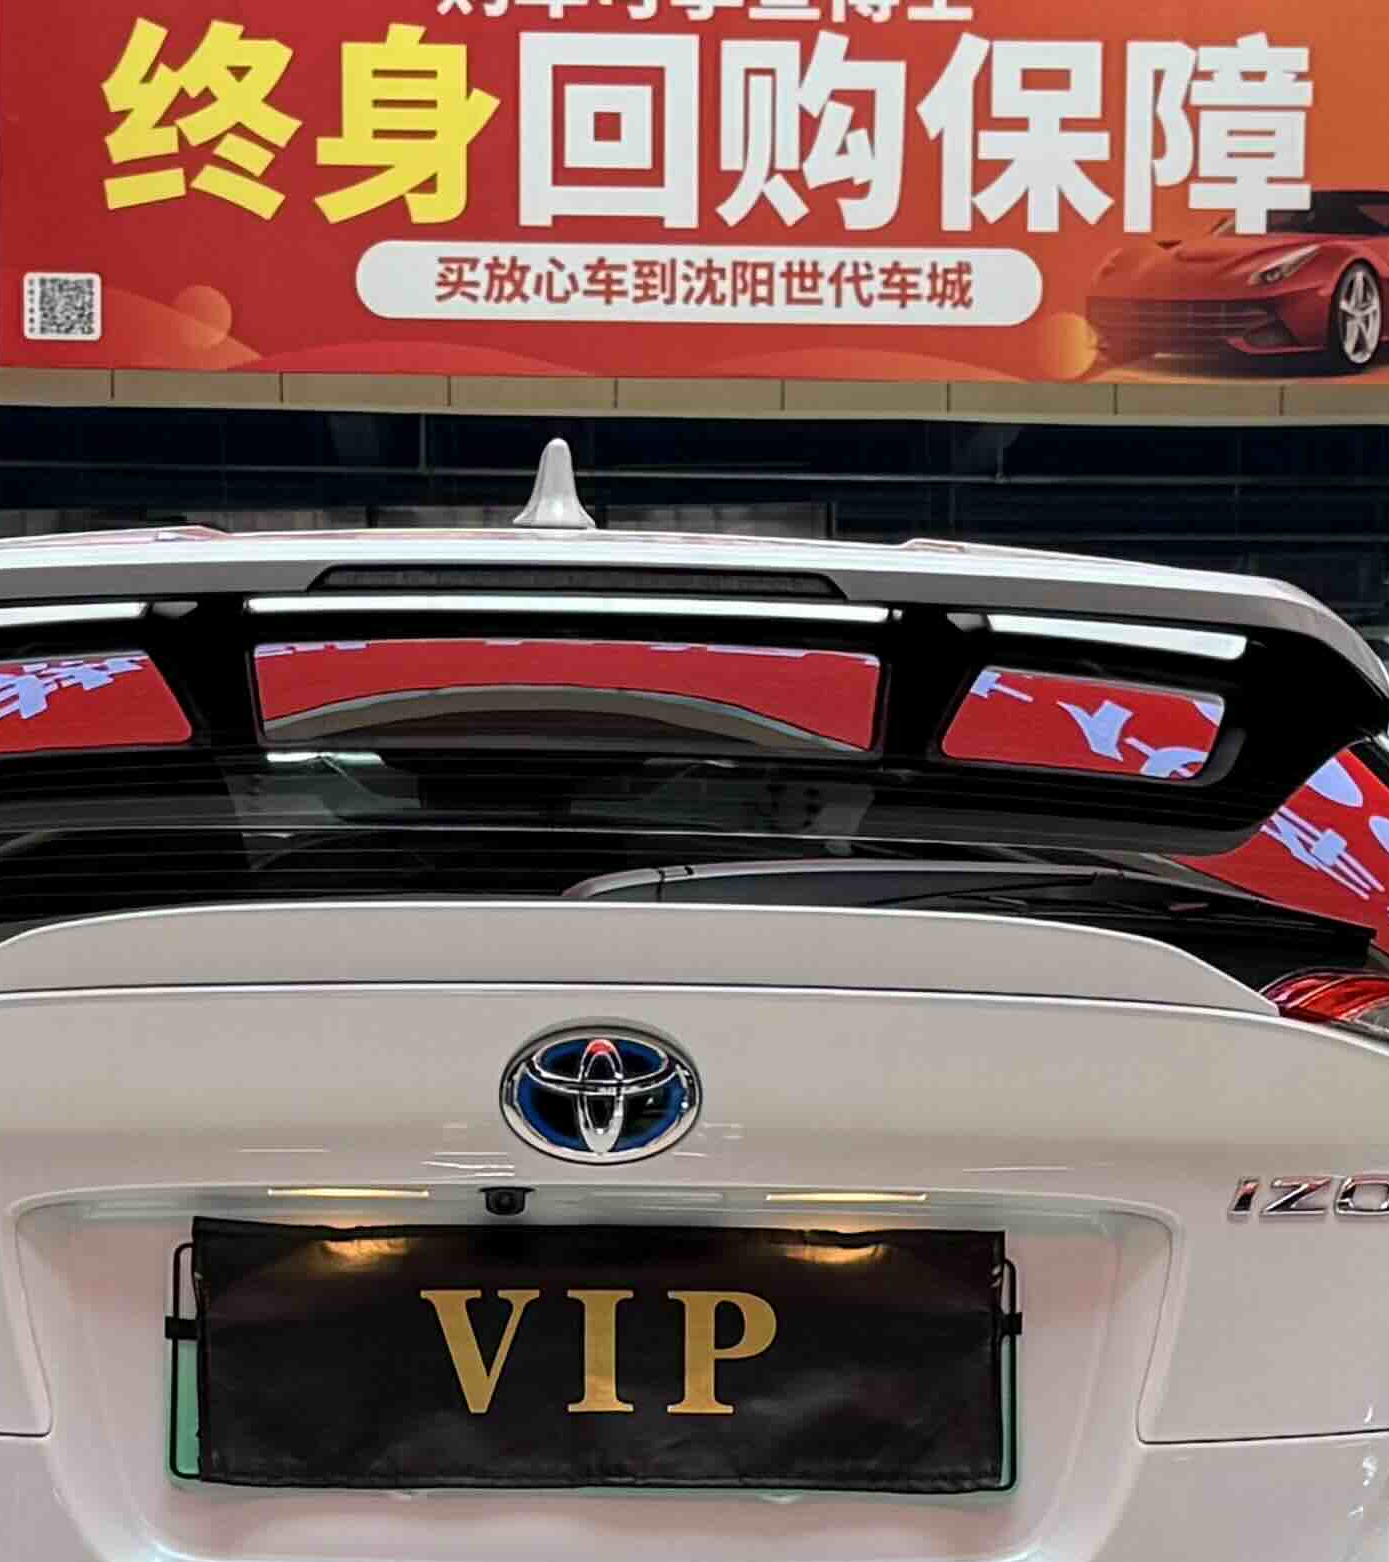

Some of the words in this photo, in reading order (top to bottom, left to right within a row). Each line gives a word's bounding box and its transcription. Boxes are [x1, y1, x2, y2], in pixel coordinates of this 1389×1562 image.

[101, 17, 1314, 235] 终身回购保障
[436, 255, 974, 311] 买放心车到沈阳世代车城
[419, 1288, 778, 1415] VIP
